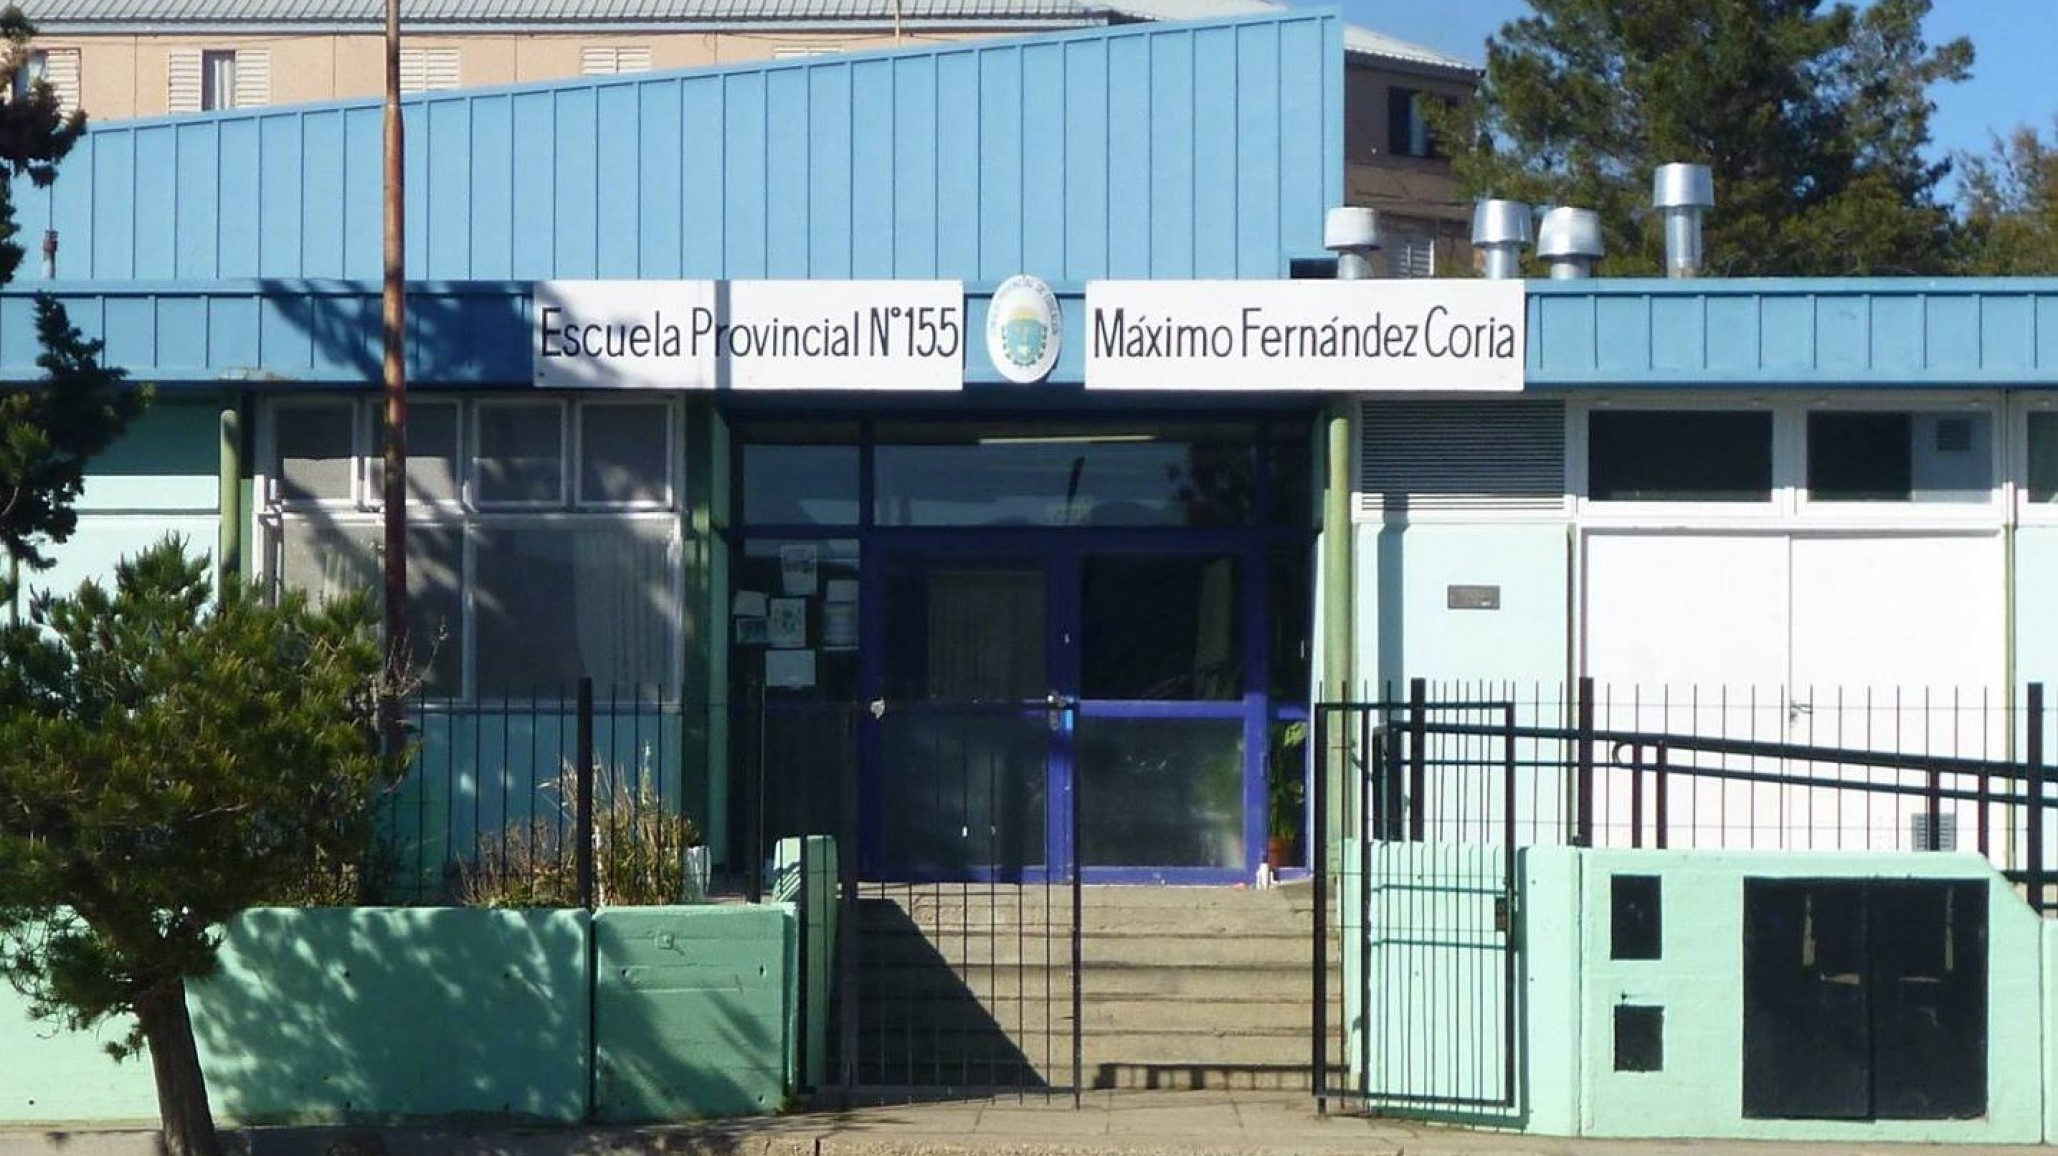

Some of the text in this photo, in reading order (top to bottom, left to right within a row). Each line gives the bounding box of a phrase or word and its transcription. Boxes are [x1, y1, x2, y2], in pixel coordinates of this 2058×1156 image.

[541, 306, 680, 358] Escuela
[692, 307, 860, 358] Provincial
[1094, 305, 1515, 358] Máximo Fernández Coria
